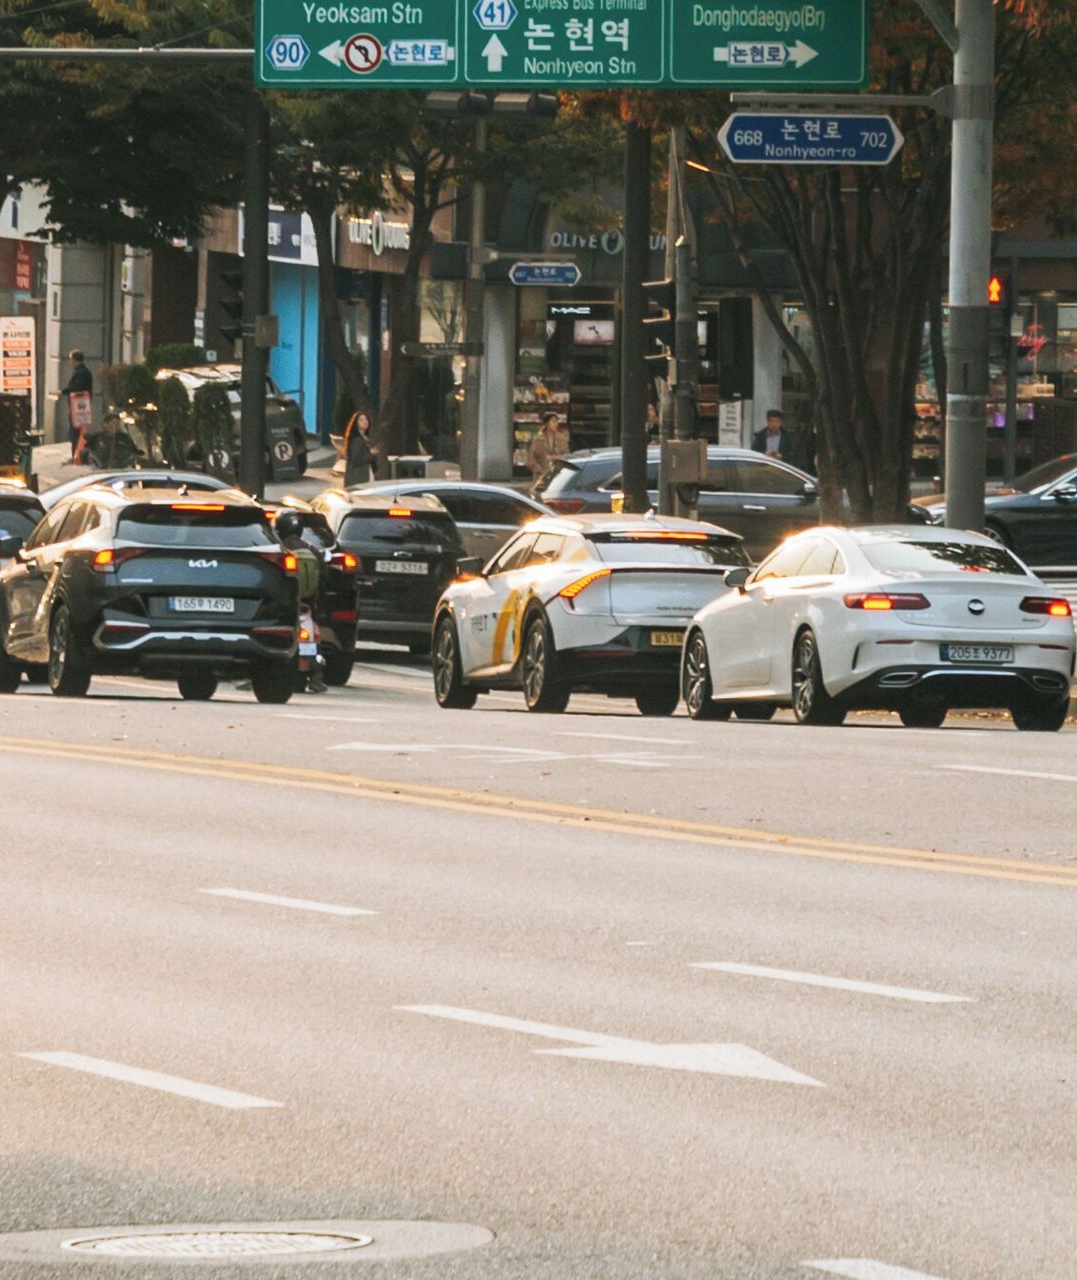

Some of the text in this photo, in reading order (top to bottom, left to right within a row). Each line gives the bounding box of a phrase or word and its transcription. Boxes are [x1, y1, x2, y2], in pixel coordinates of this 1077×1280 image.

[303, 1, 423, 24] Yeoksam Stn
[482, 2, 507, 24] 41
[692, 3, 825, 31] Donghodaegyo(Br)
[523, 17, 630, 52] 논현역
[273, 42, 301, 63] 90
[392, 42, 445, 63] 논현로
[730, 44, 784, 65] 논현로
[523, 56, 636, 78] Nonhyeon Stn
[733, 129, 763, 146] 668
[780, 119, 842, 141] 논현로
[860, 131, 888, 148] 702
[764, 143, 857, 161] Nonhyeon-ro
[550, 232, 598, 249] OLIVE
